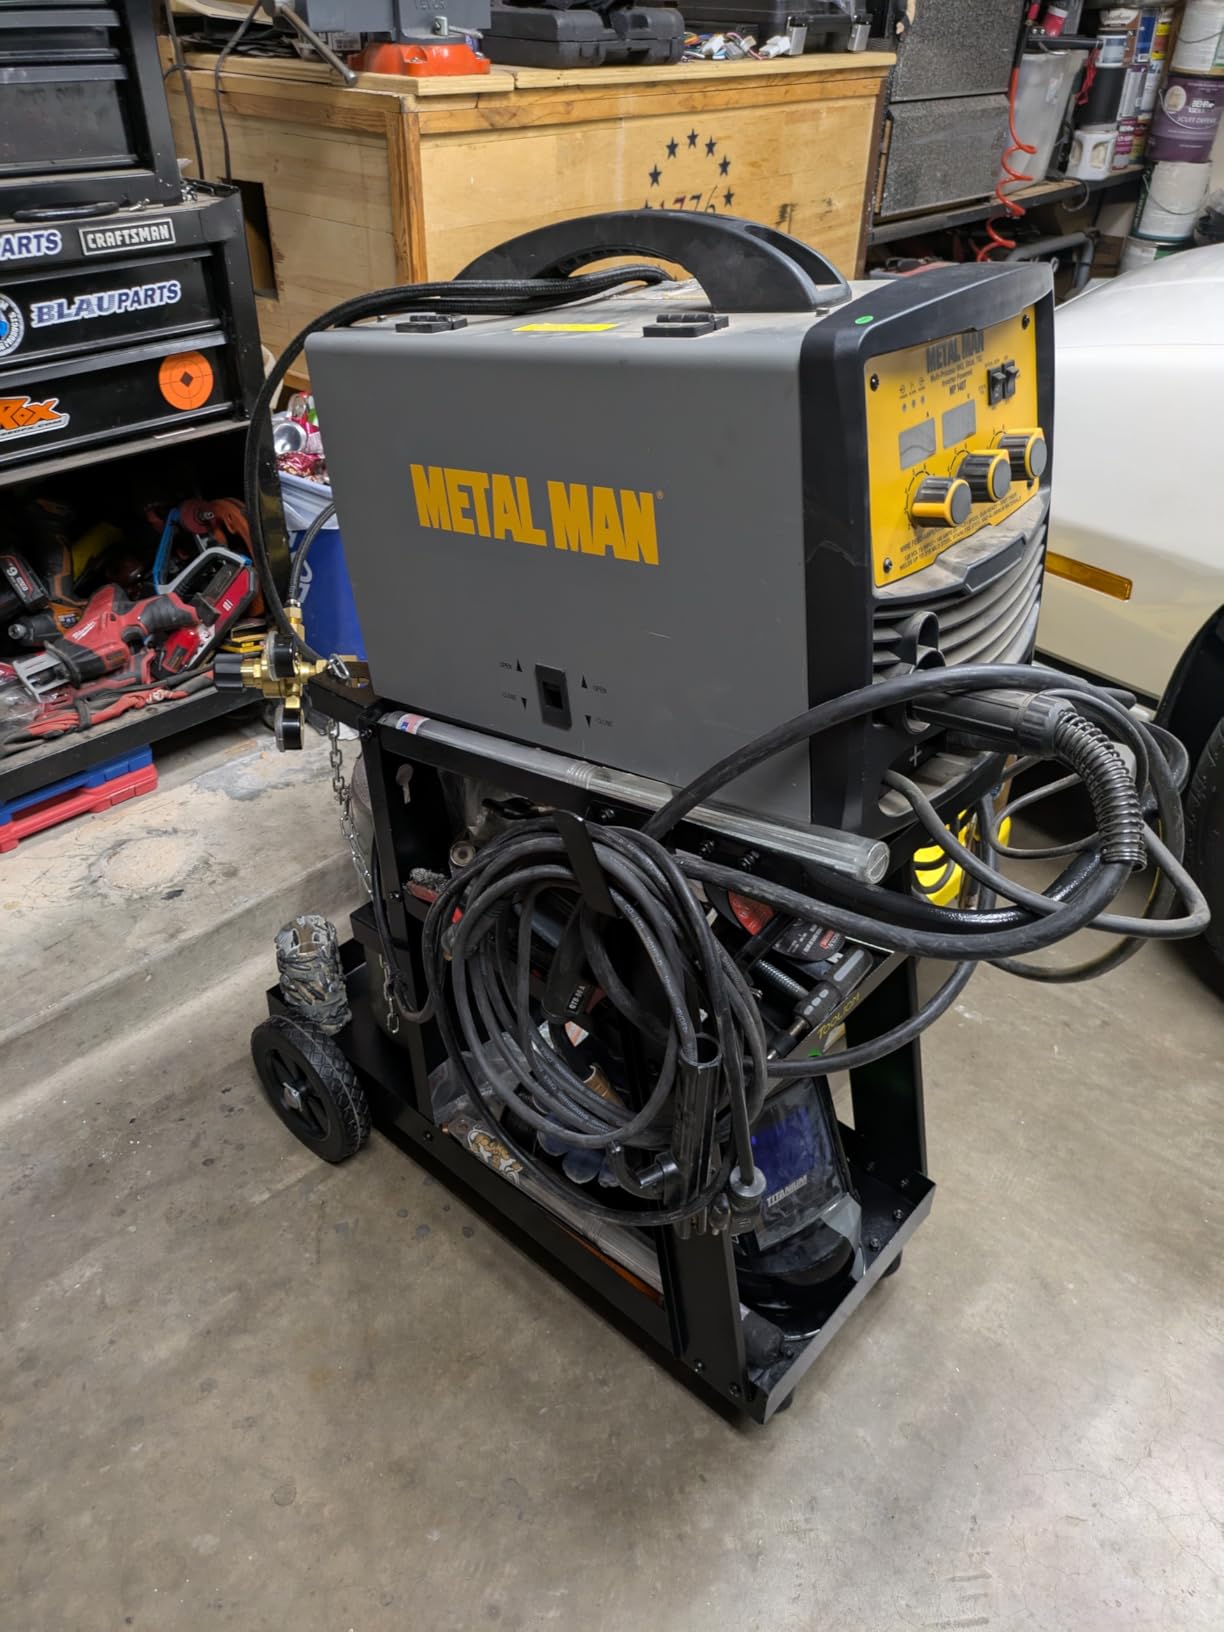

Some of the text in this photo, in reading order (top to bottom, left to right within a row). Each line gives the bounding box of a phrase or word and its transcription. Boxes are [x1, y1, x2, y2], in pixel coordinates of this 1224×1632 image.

[87, 224, 170, 249] CRAFTSMAN
[34, 282, 180, 326] BLAUPARTS
[926, 331, 984, 373] METAL MAN
[410, 463, 659, 565] METAL MAN
[767, 1174, 808, 1208] TITANIUM
